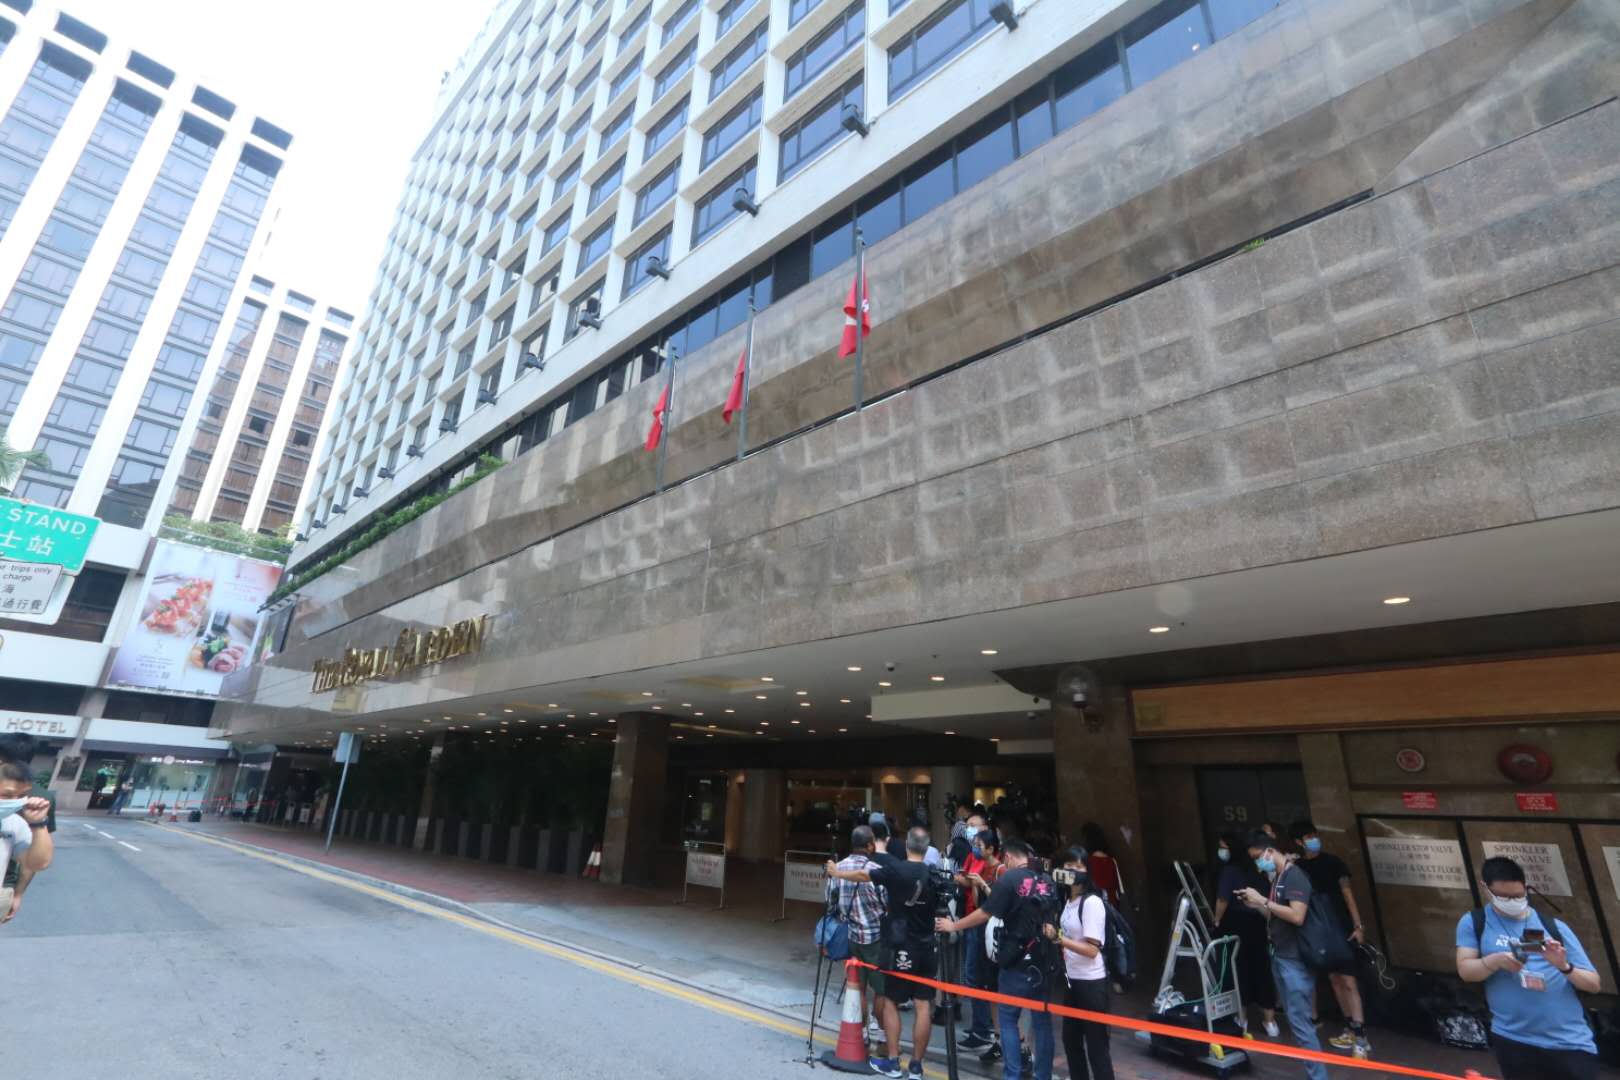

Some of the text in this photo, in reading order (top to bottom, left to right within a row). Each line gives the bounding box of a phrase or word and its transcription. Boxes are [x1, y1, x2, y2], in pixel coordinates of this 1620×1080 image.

[8, 508, 87, 535] STAND
[34, 566, 54, 574] only
[2, 573, 33, 582] charge
[393, 614, 487, 675] GARDEN
[6, 717, 67, 734] HOTEL
[1494, 845, 1550, 855] SPRINKLER
[1520, 855, 1552, 864] VALVE
